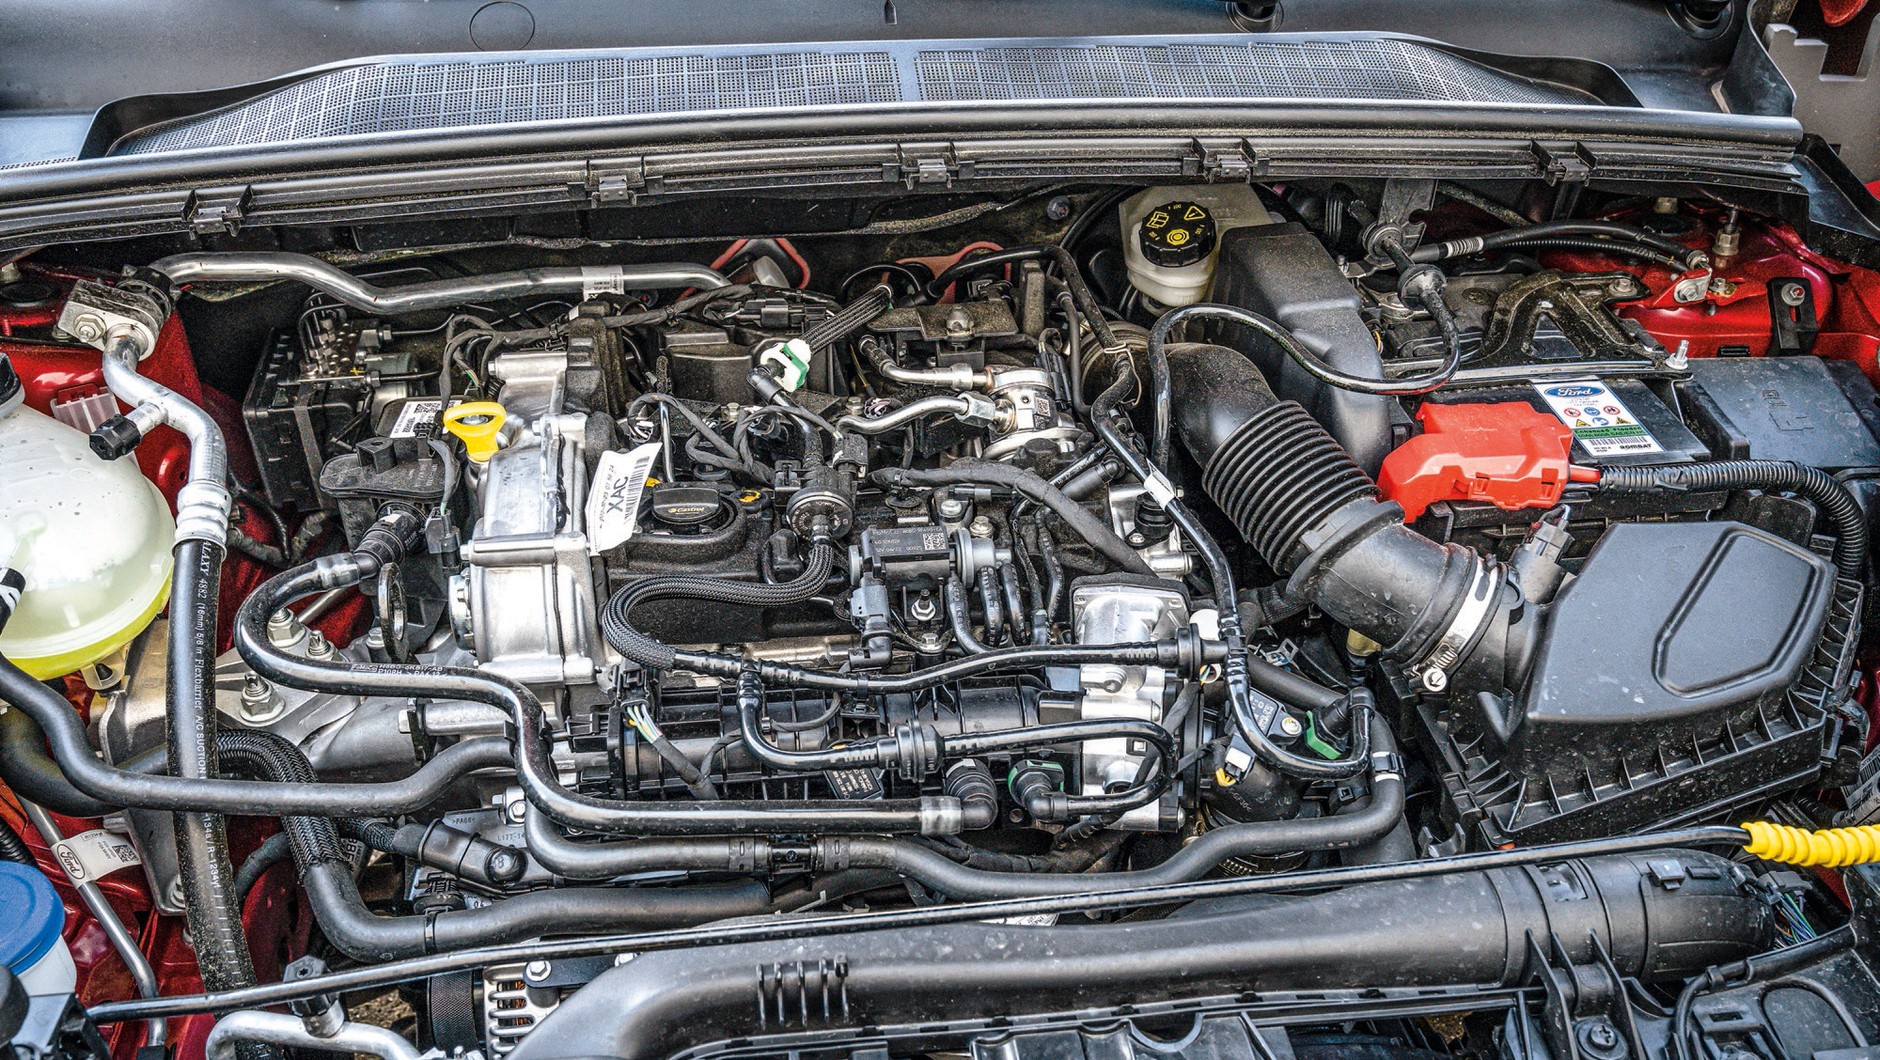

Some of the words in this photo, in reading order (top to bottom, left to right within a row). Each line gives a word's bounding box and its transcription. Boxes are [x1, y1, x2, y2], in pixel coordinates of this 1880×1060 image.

[1557, 386, 1593, 397] Ford
[606, 475, 629, 513] XAC
[197, 579, 208, 598] 4882
[194, 659, 205, 710] Flexbarrier
[195, 715, 204, 731] A/C
[196, 733, 206, 774] SUCTION
[60, 852, 80, 873] Ford
